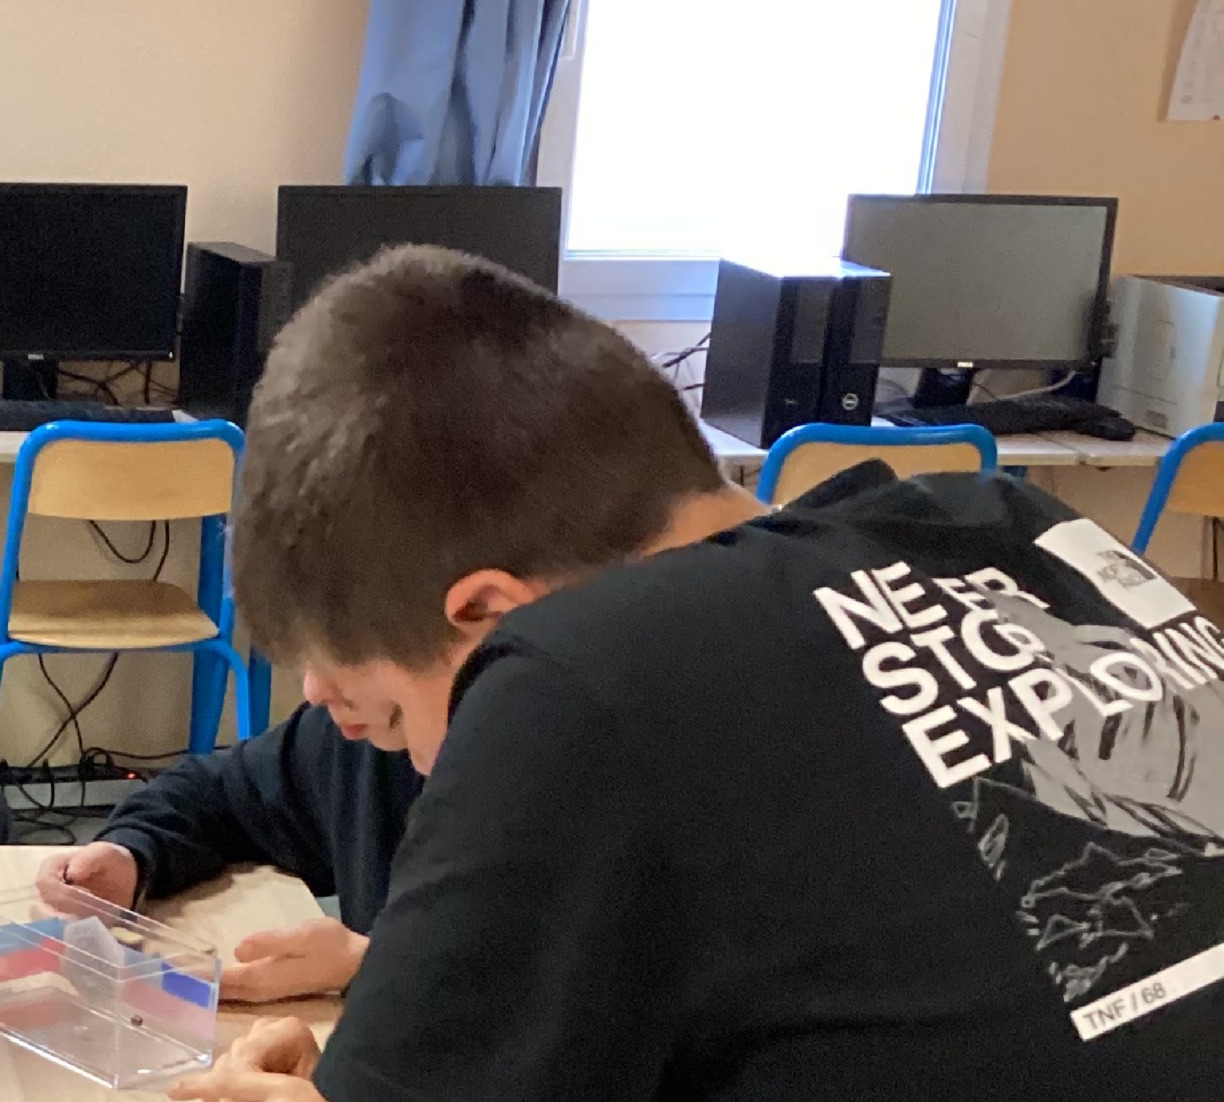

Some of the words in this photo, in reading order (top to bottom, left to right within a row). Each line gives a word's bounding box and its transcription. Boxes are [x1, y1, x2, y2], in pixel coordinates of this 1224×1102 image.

[813, 561, 1050, 650] NEER
[1083, 999, 1127, 1030] TNF
[1141, 982, 1166, 1004] 68
